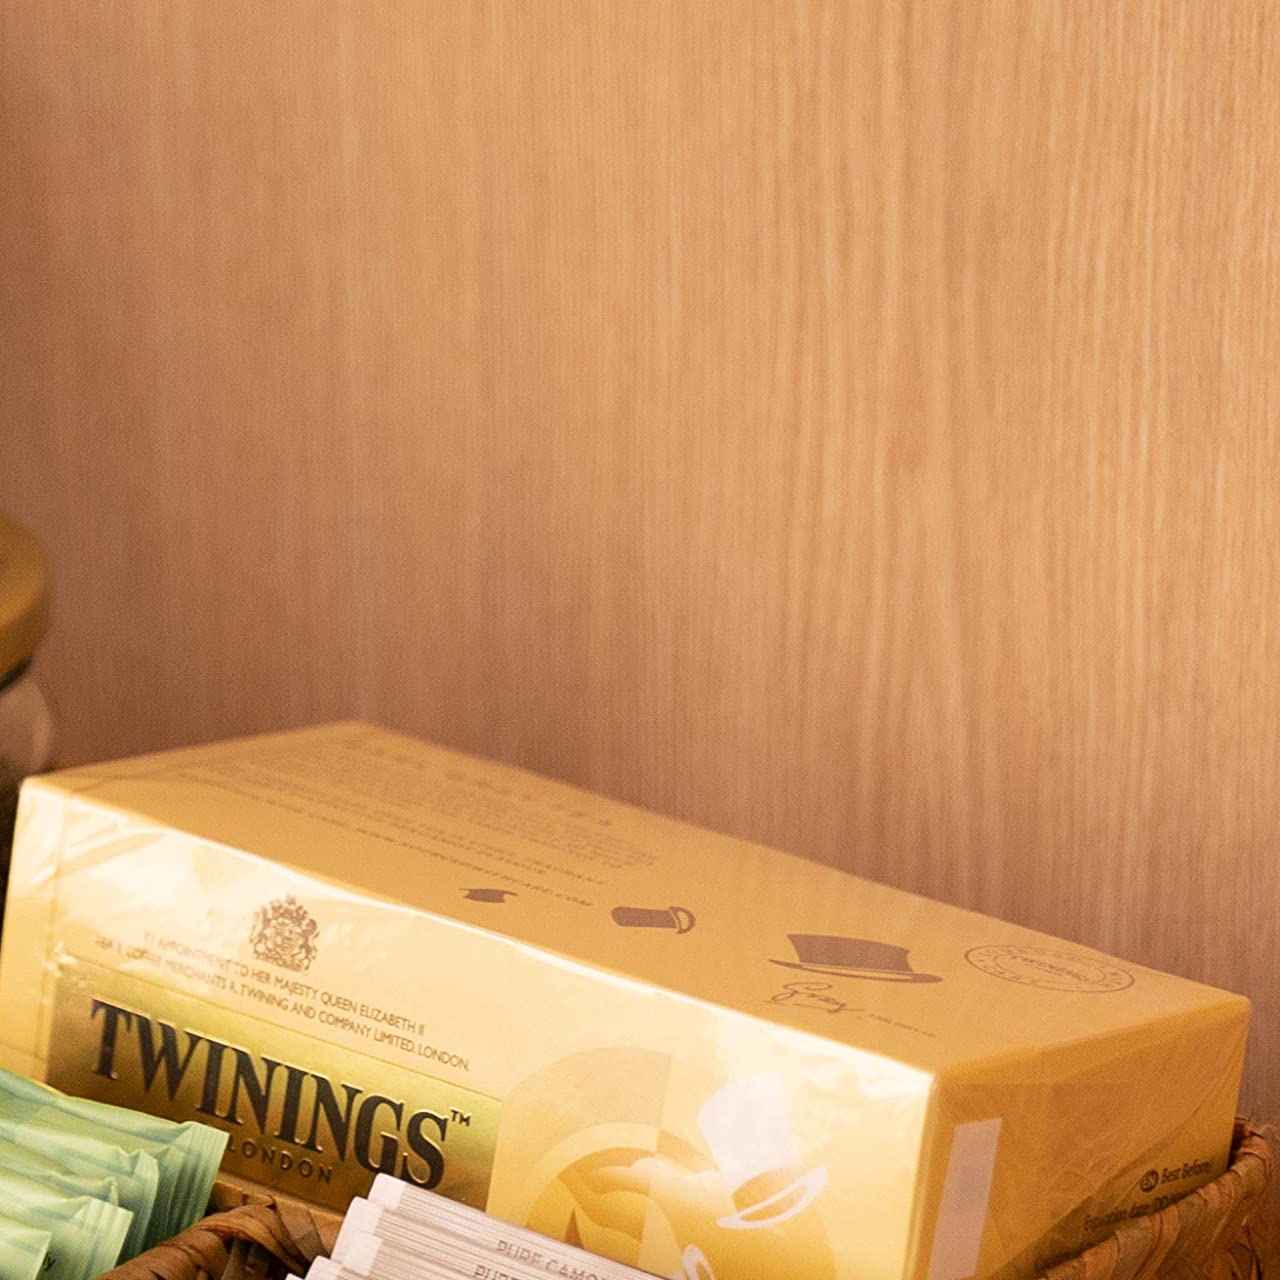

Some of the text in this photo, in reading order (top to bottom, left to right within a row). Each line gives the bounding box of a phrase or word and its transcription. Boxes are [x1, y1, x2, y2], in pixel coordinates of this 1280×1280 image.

[250, 968, 271, 985] HER
[274, 975, 320, 998] MAJESTY
[320, 991, 359, 1014] QUEEN
[359, 1004, 417, 1034] ELIZABETH
[291, 1001, 317, 1019] AND
[319, 1010, 373, 1038] COMPANY
[90, 998, 449, 1190] TWININGS
[227, 1136, 334, 1184] LONDON
[497, 1239, 540, 1267] PURE
